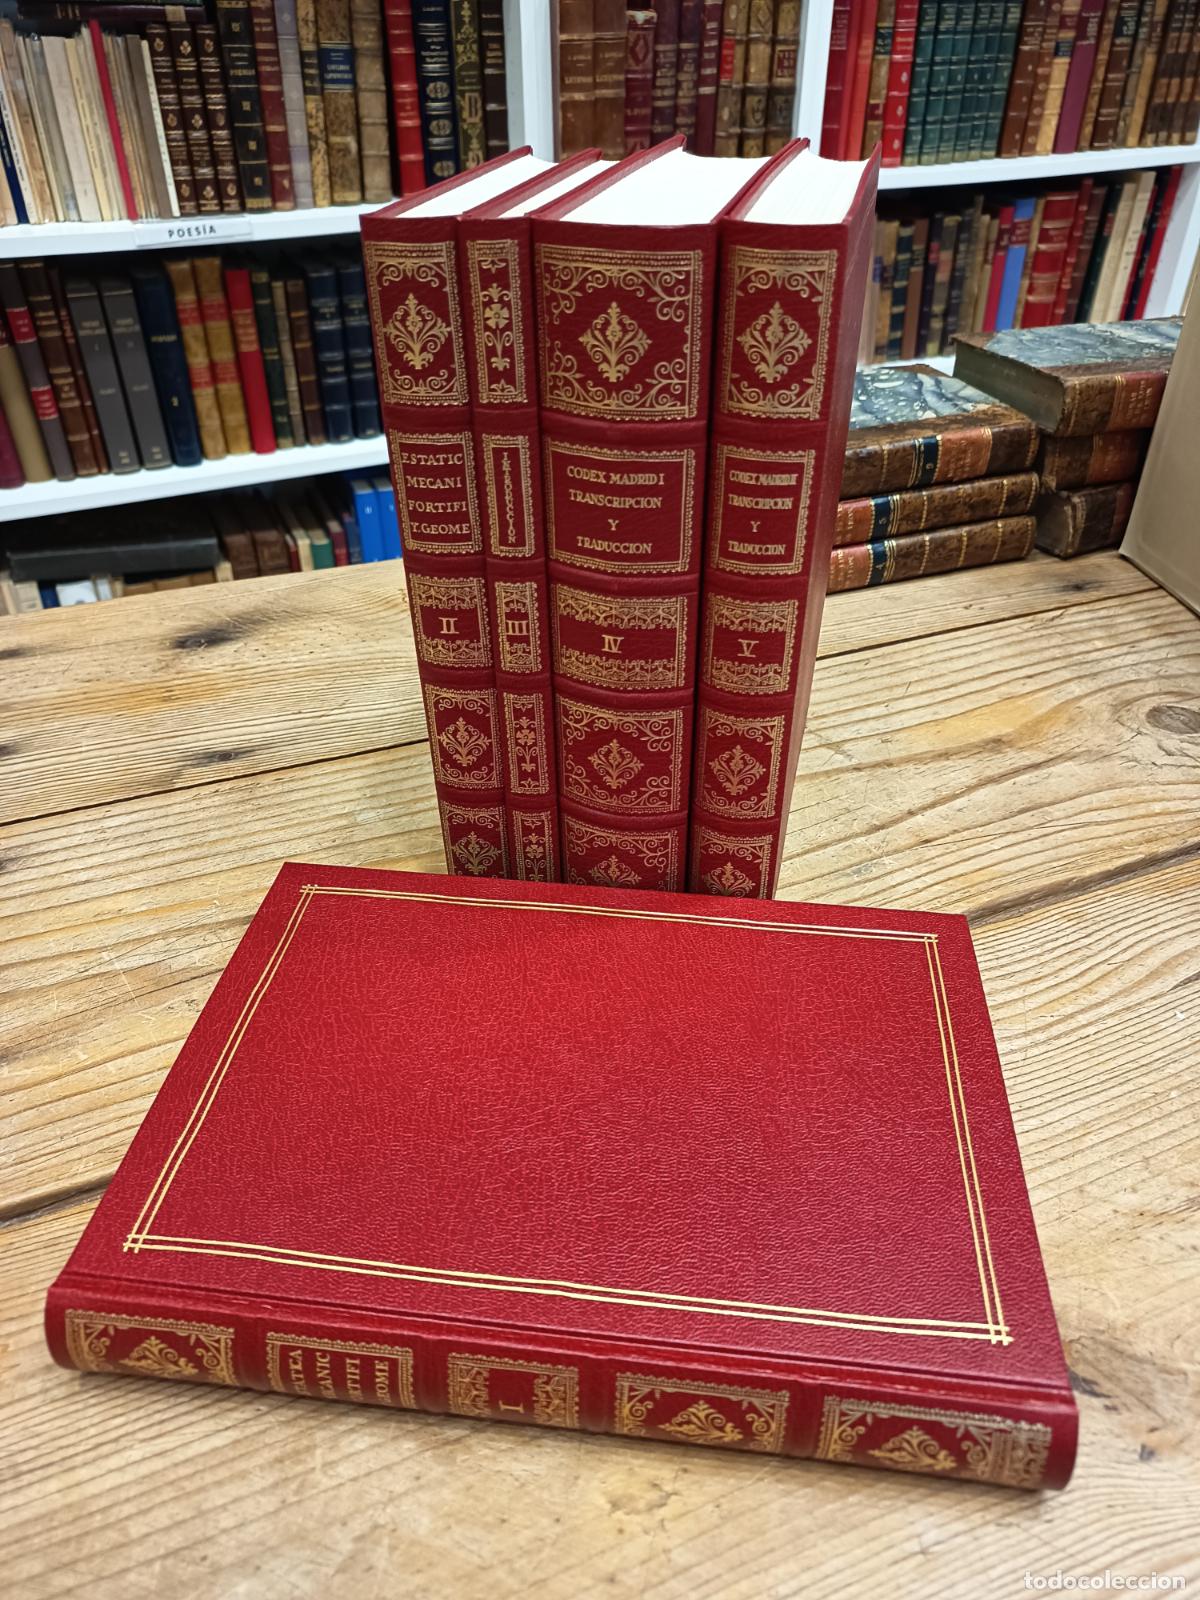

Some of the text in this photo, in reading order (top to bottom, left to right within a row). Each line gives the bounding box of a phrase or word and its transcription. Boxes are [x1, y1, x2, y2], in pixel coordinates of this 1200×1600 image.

[167, 223, 217, 239] POESÍA
[401, 452, 464, 466] ESTATIC
[405, 475, 463, 489] MECANI
[566, 465, 665, 486] CODEX MADRID I
[501, 451, 516, 544] INTRODUCCION
[568, 488, 663, 509] TRANSCRIPCION
[407, 499, 468, 513] FORTIFI
[607, 518, 620, 531] Y
[749, 520, 761, 533] Y
[576, 535, 653, 554] TRADUCCION
[727, 540, 787, 555] TRADUCCION
[438, 616, 460, 634] II
[505, 620, 530, 636] III
[601, 634, 625, 653] IV
[737, 638, 760, 657] V
